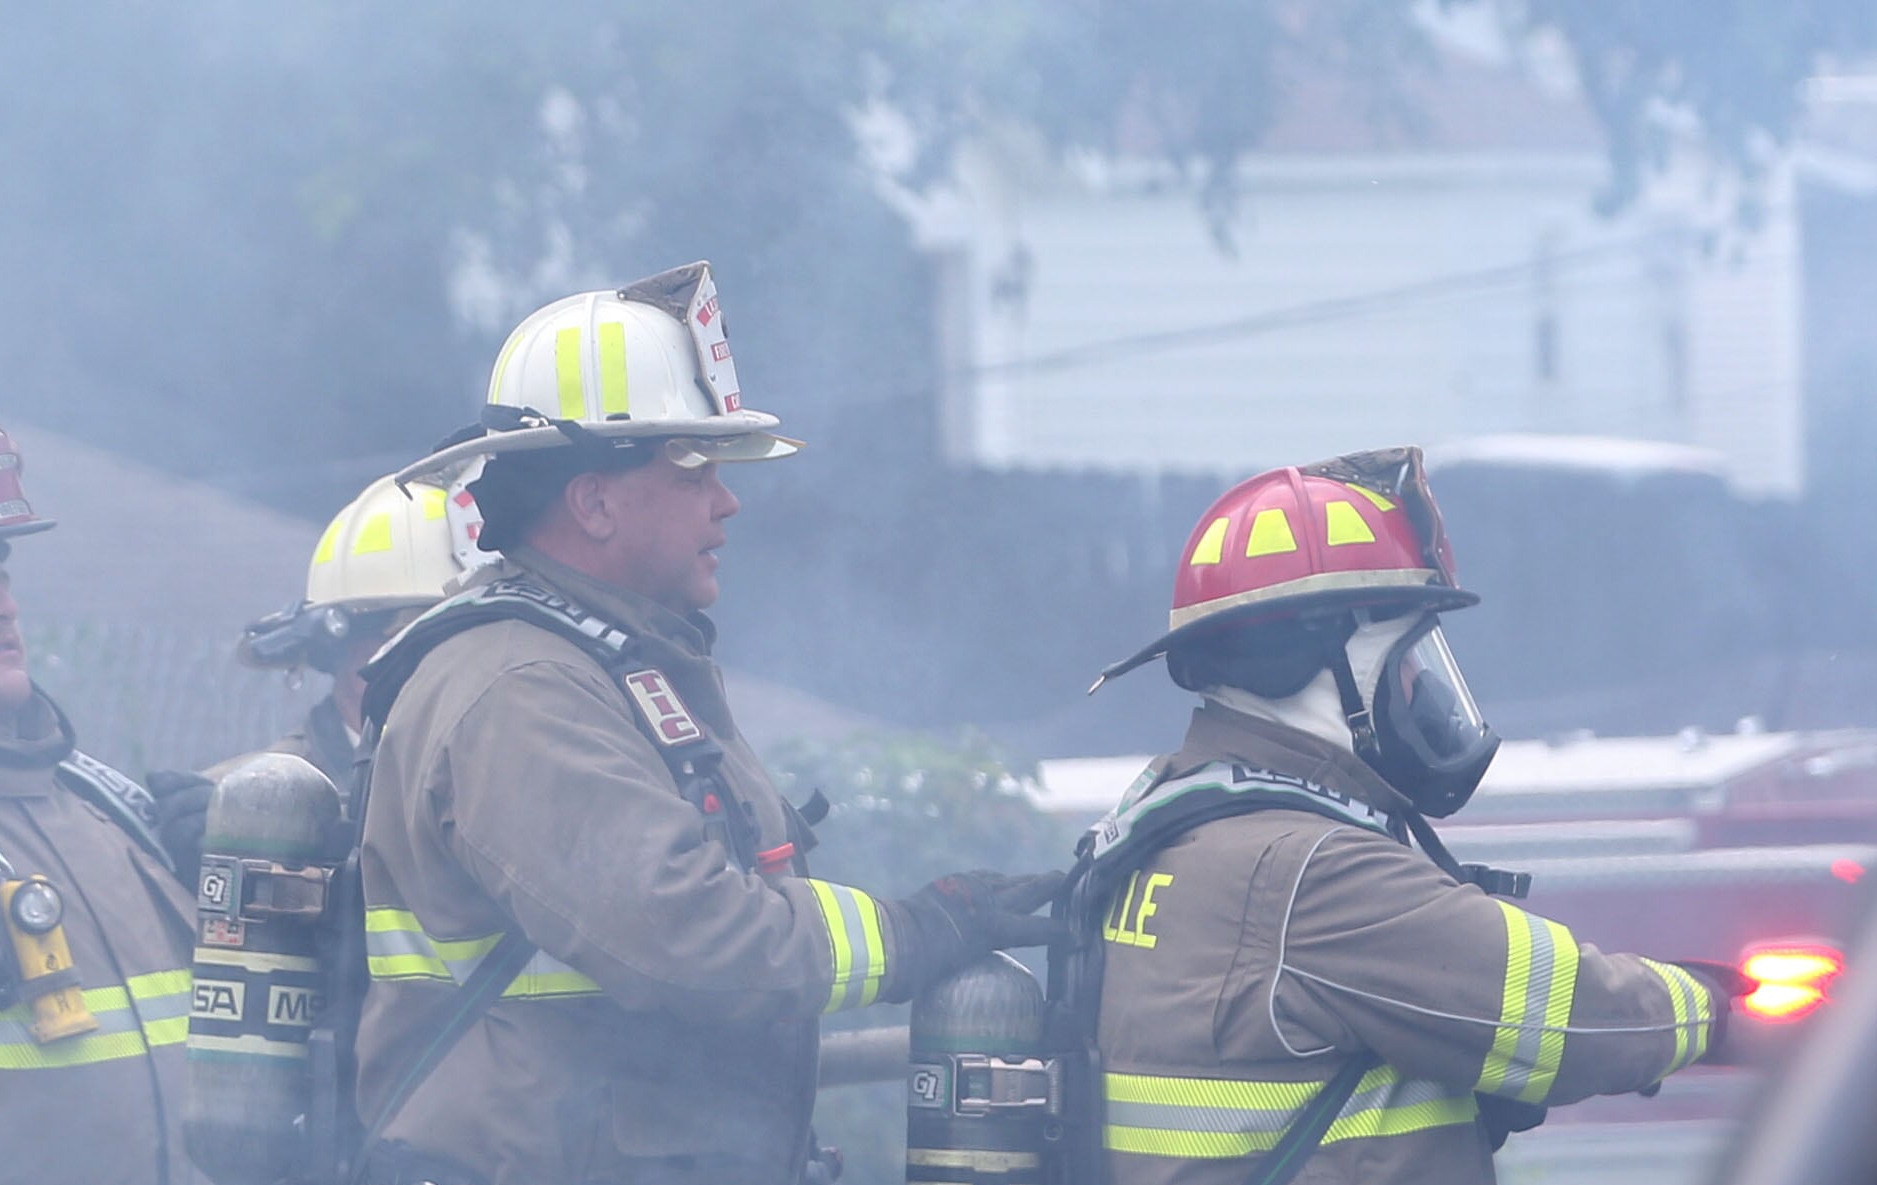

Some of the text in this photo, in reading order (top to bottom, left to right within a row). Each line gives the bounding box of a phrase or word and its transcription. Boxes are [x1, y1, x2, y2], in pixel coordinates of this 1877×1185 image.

[203, 875, 225, 902] G1
[191, 984, 238, 1016] SA
[913, 1072, 938, 1099] G1
